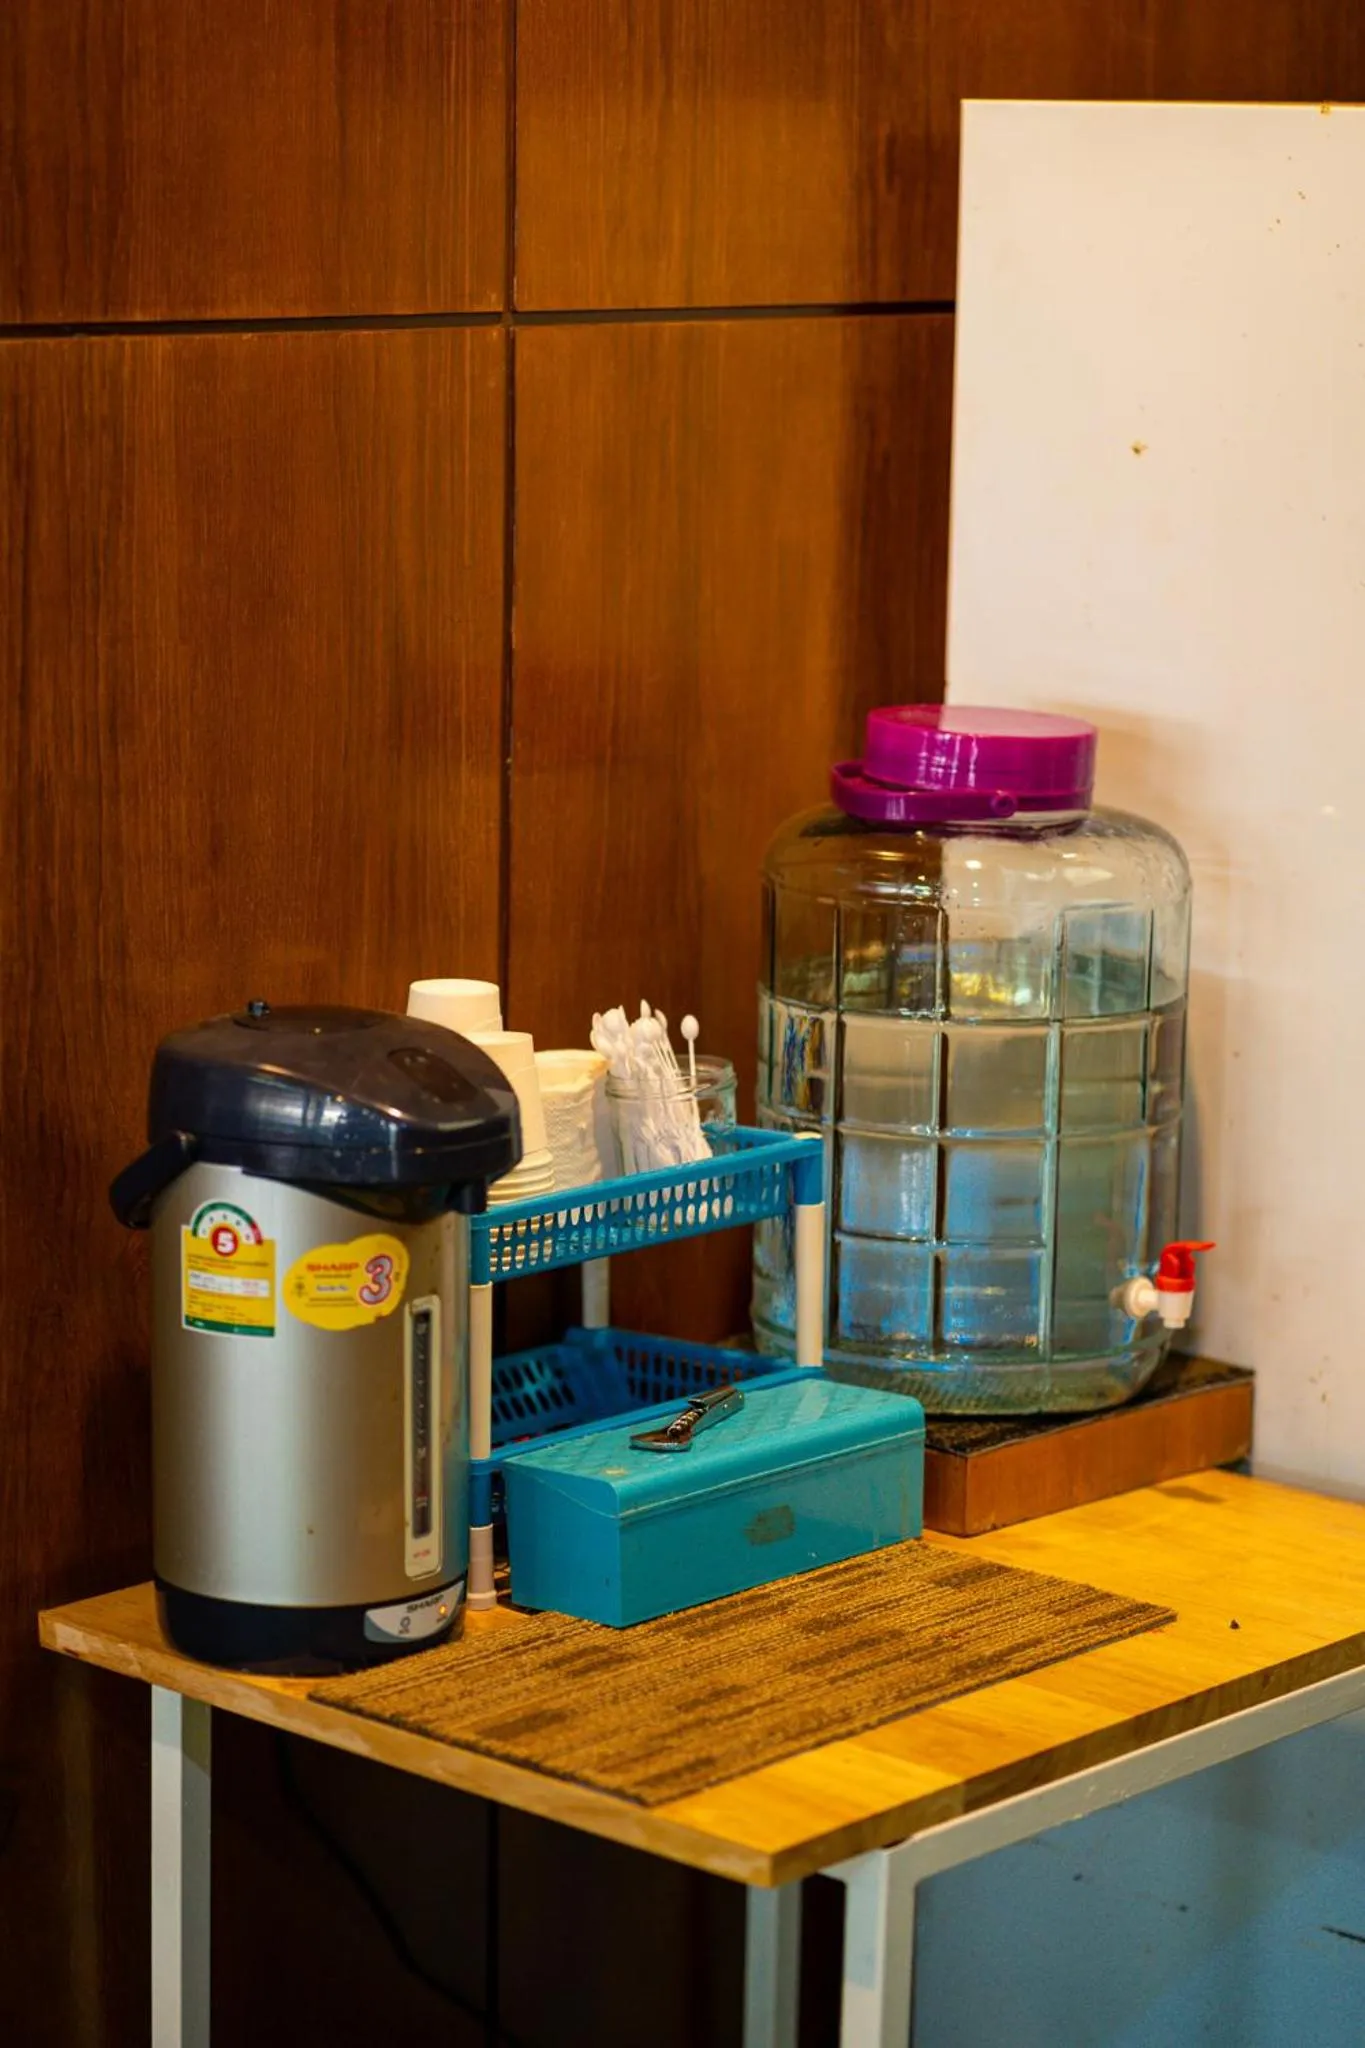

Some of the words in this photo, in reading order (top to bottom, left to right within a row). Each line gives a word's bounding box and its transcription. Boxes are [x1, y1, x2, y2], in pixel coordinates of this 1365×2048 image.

[217, 1230, 236, 1253] 5
[306, 1262, 360, 1272] SHARP
[358, 1254, 394, 1305] 3
[406, 1594, 445, 1613] SHARP
